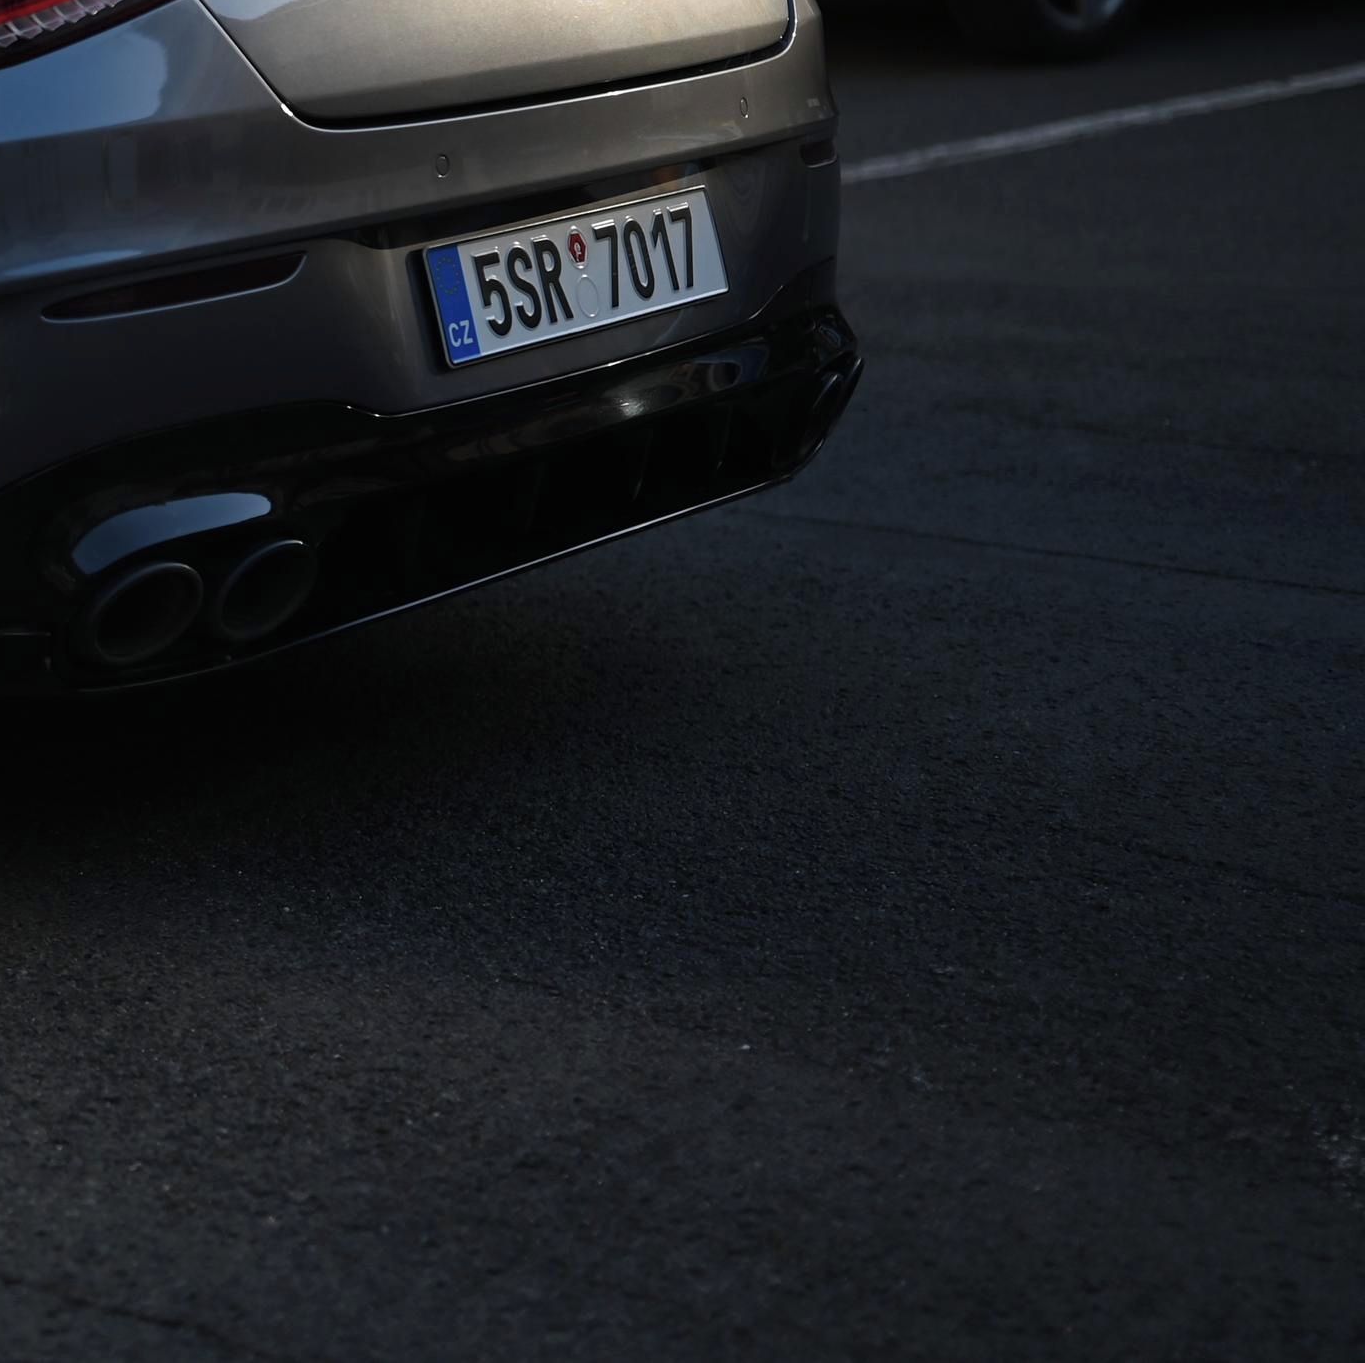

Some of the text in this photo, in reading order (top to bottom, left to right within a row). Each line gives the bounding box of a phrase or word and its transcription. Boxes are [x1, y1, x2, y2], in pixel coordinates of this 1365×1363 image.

[471, 201, 694, 337] 5SR 7017
[448, 319, 474, 347] CZ
